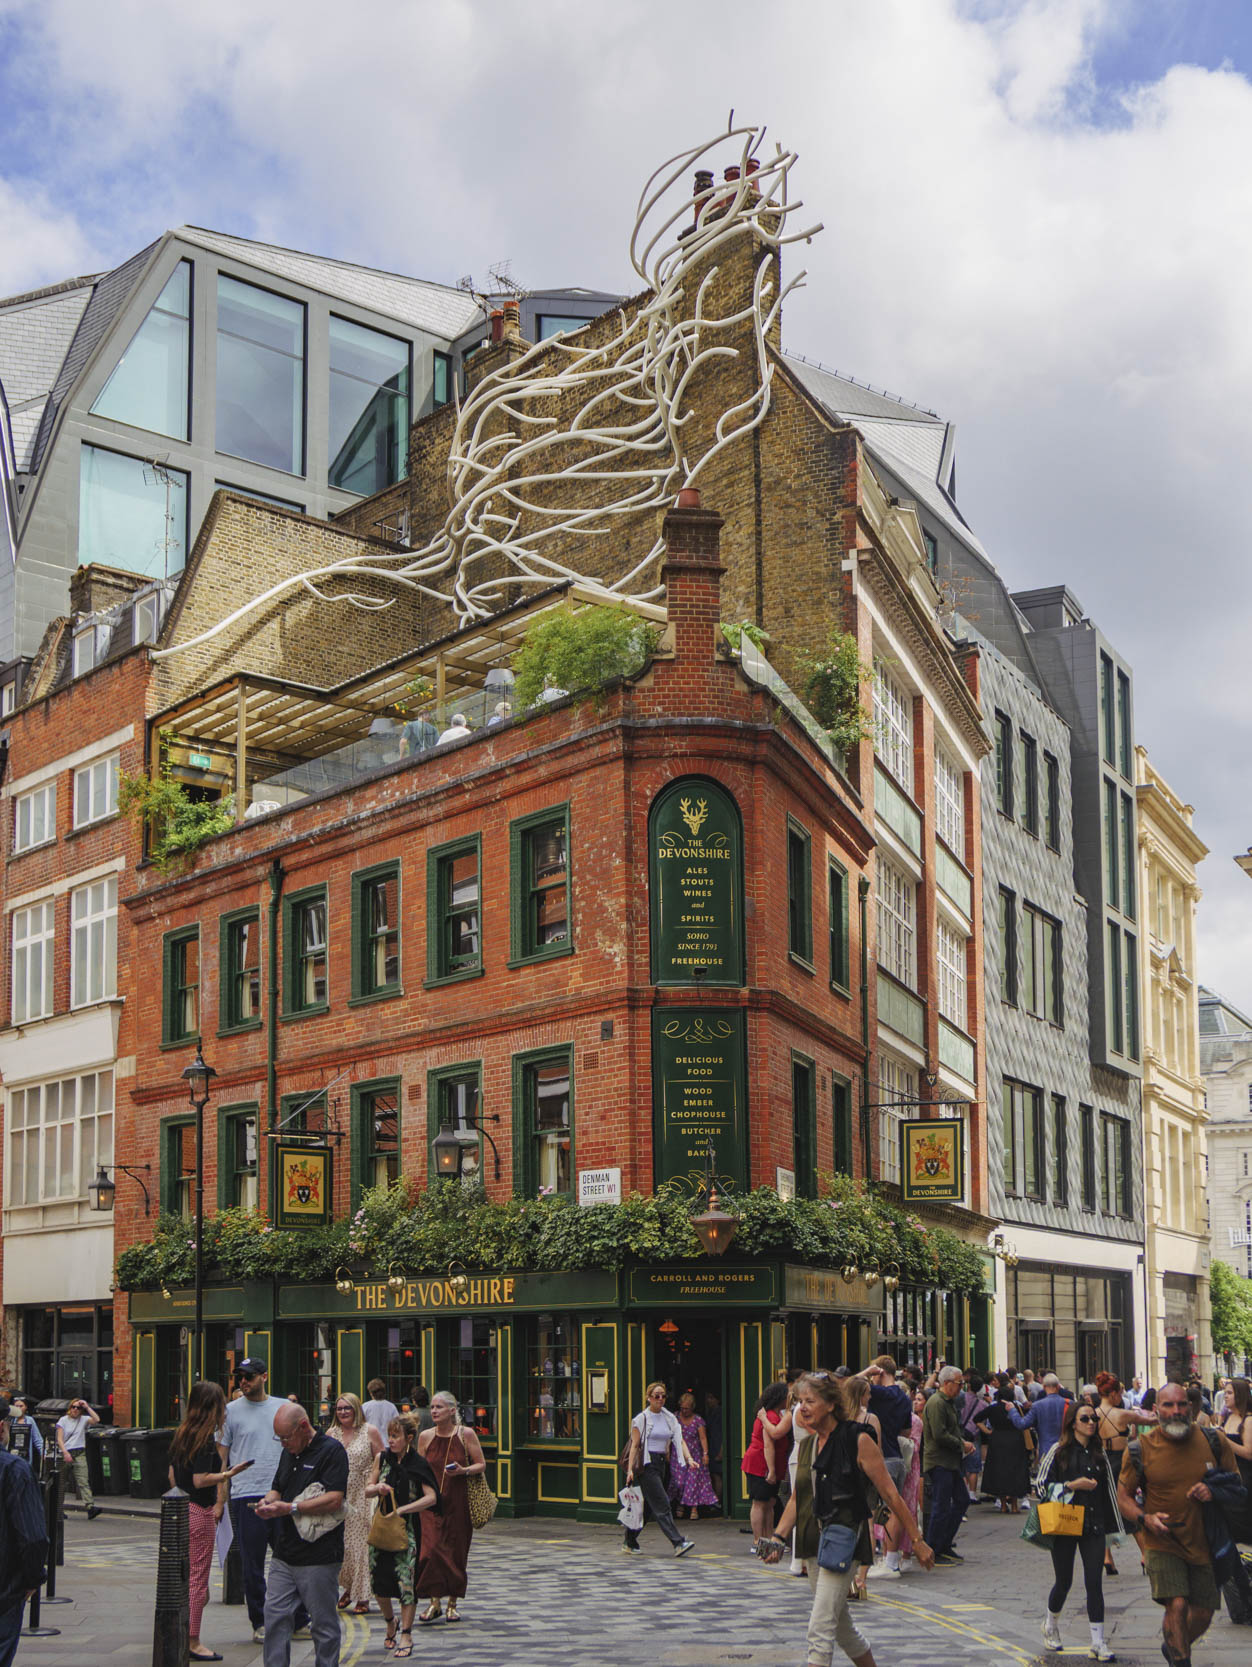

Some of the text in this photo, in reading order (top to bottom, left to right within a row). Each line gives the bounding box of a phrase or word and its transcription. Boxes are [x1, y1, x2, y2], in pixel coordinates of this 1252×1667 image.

[688, 839, 703, 847] THE
[659, 848, 731, 859] DEVONSHIRE
[680, 878, 714, 886] STOUTS
[687, 932, 709, 940] SOHO
[671, 957, 723, 965] FREEHOUSE
[684, 1087, 713, 1095] WOOD
[683, 1099, 713, 1107] EMBER
[582, 1173, 610, 1184] DENMAN
[582, 1184, 606, 1196] STREET
[718, 1274, 756, 1282] ROGERS
[680, 1286, 726, 1294] FREEHOUSE
[354, 1284, 387, 1310] THE
